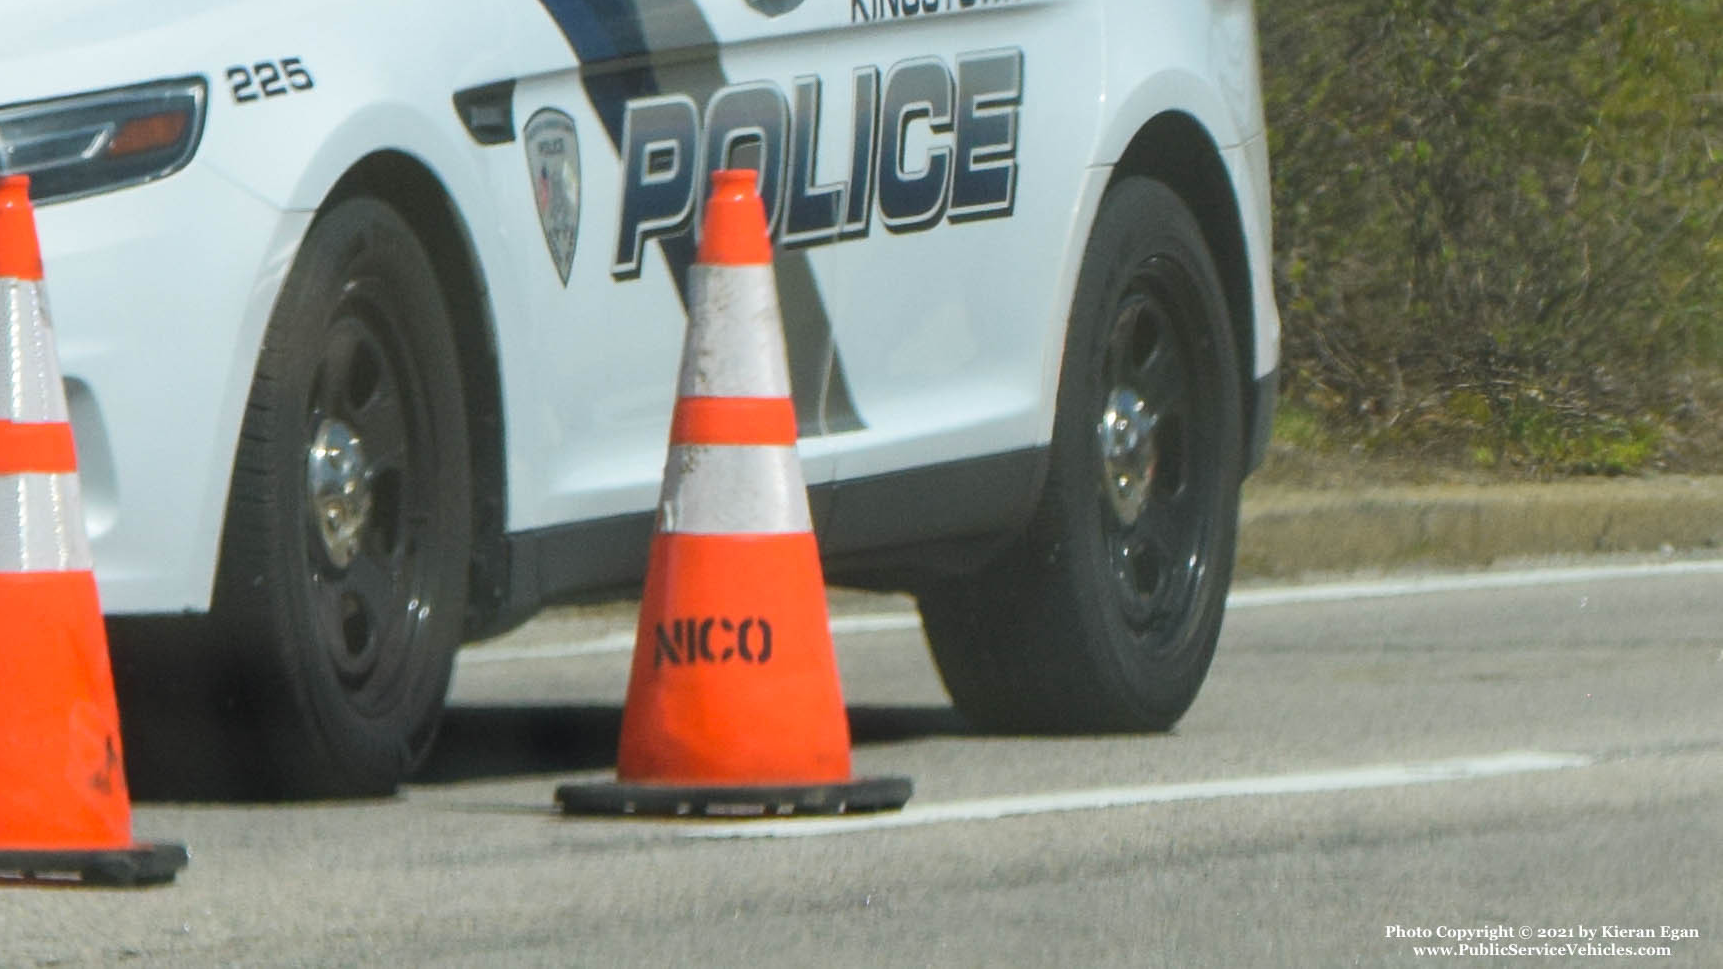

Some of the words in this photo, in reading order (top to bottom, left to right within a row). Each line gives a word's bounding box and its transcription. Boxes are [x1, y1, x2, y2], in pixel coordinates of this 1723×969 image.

[226, 57, 315, 103] 225
[609, 45, 1025, 283] POLICE
[653, 616, 773, 670] NICO
